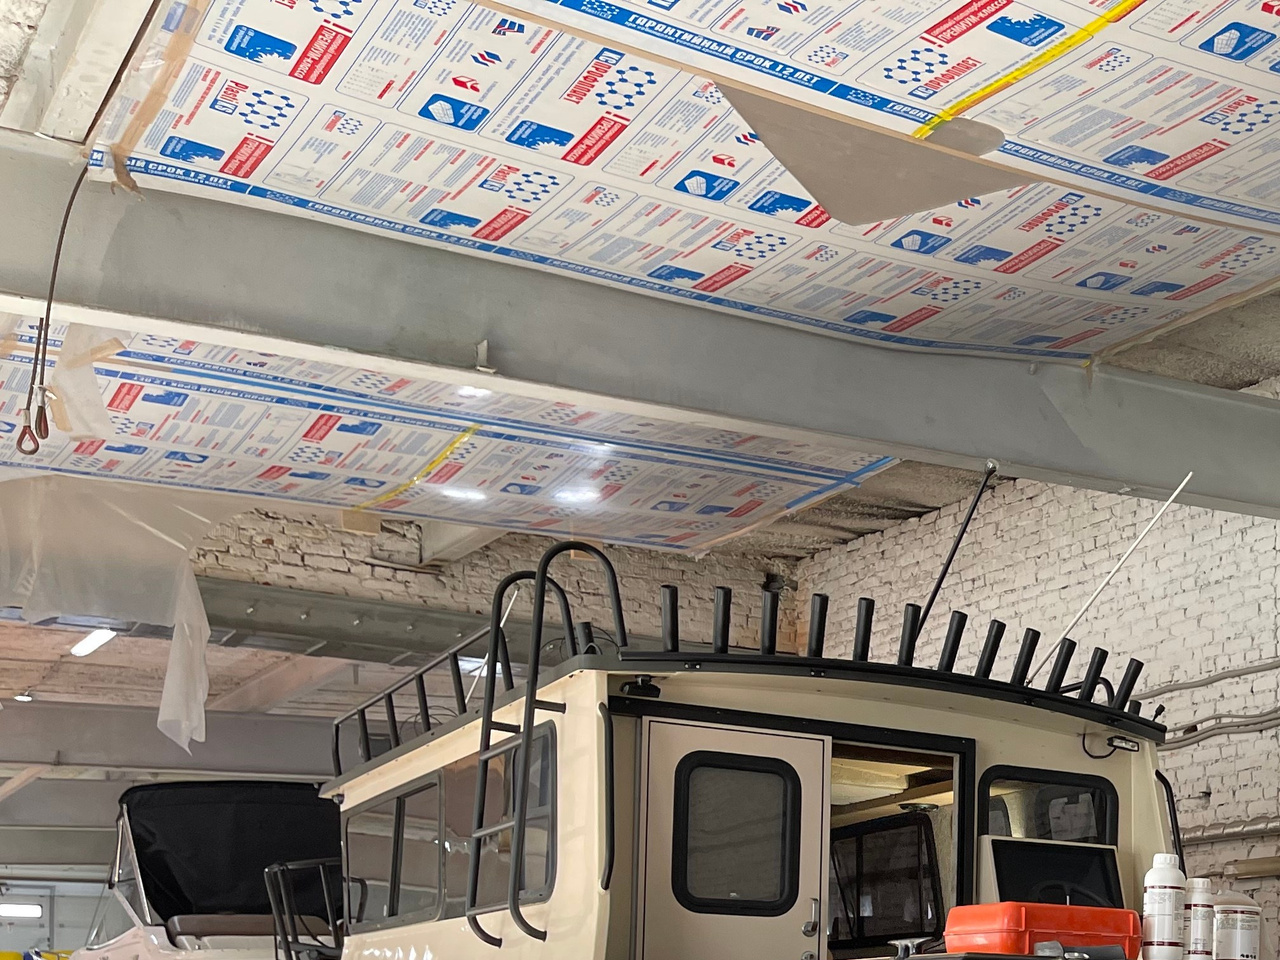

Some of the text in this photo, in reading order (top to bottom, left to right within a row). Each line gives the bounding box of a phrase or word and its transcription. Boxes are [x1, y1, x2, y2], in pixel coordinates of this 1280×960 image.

[294, 28, 337, 79] ПРЕМИУМ-класса
[628, 14, 822, 84] ГАРАНТИЙНЫЙ СРОК 12 ЛЕТ
[565, 117, 616, 162] ПРЕМИУМ-класса
[148, 162, 234, 186] СРОК 12 ЛЕТ
[1080, 166, 1109, 179] СРОК
[1112, 174, 1126, 183] 12
[1126, 178, 1148, 188] ЛЕТ
